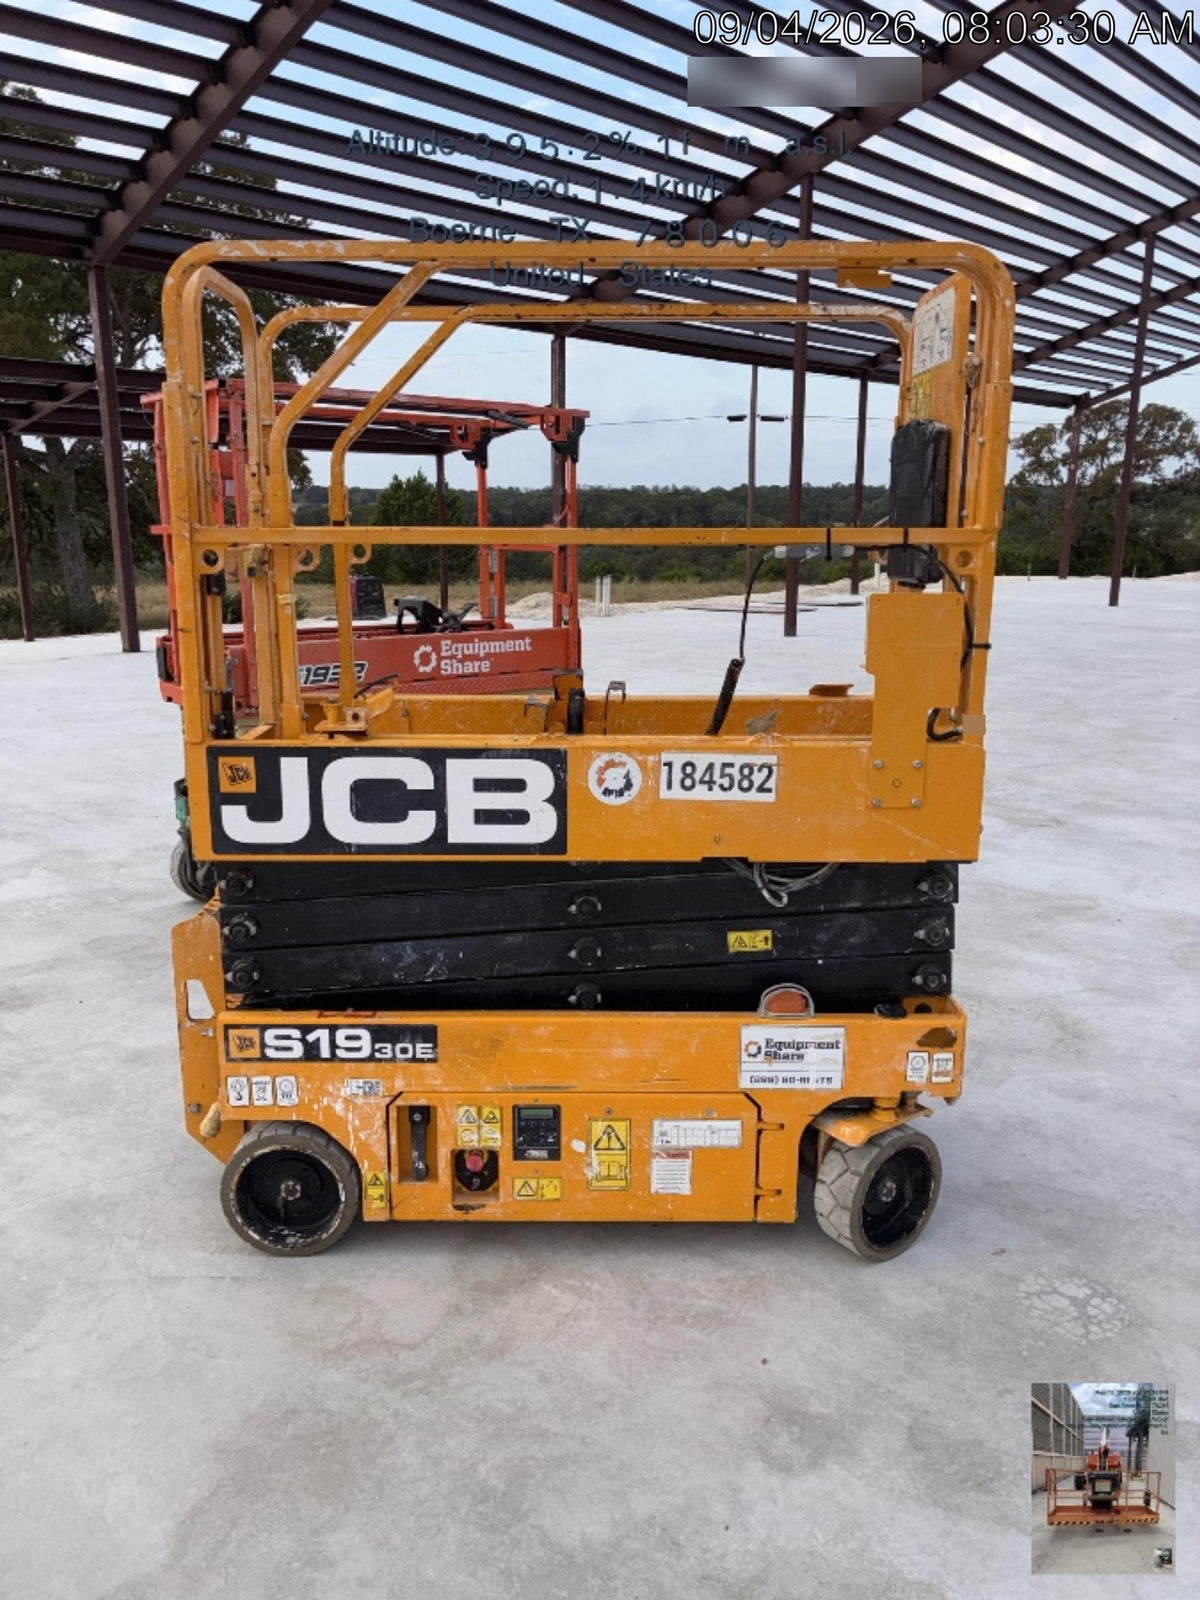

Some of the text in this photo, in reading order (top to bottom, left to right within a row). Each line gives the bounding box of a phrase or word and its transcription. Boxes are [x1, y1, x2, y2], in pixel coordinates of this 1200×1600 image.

[440, 636, 532, 658] Equipment
[440, 658, 491, 675] Share
[663, 760, 774, 794] 184582
[220, 756, 559, 844] JCB
[764, 1038, 841, 1051] Equipment
[764, 1050, 805, 1061] Share
